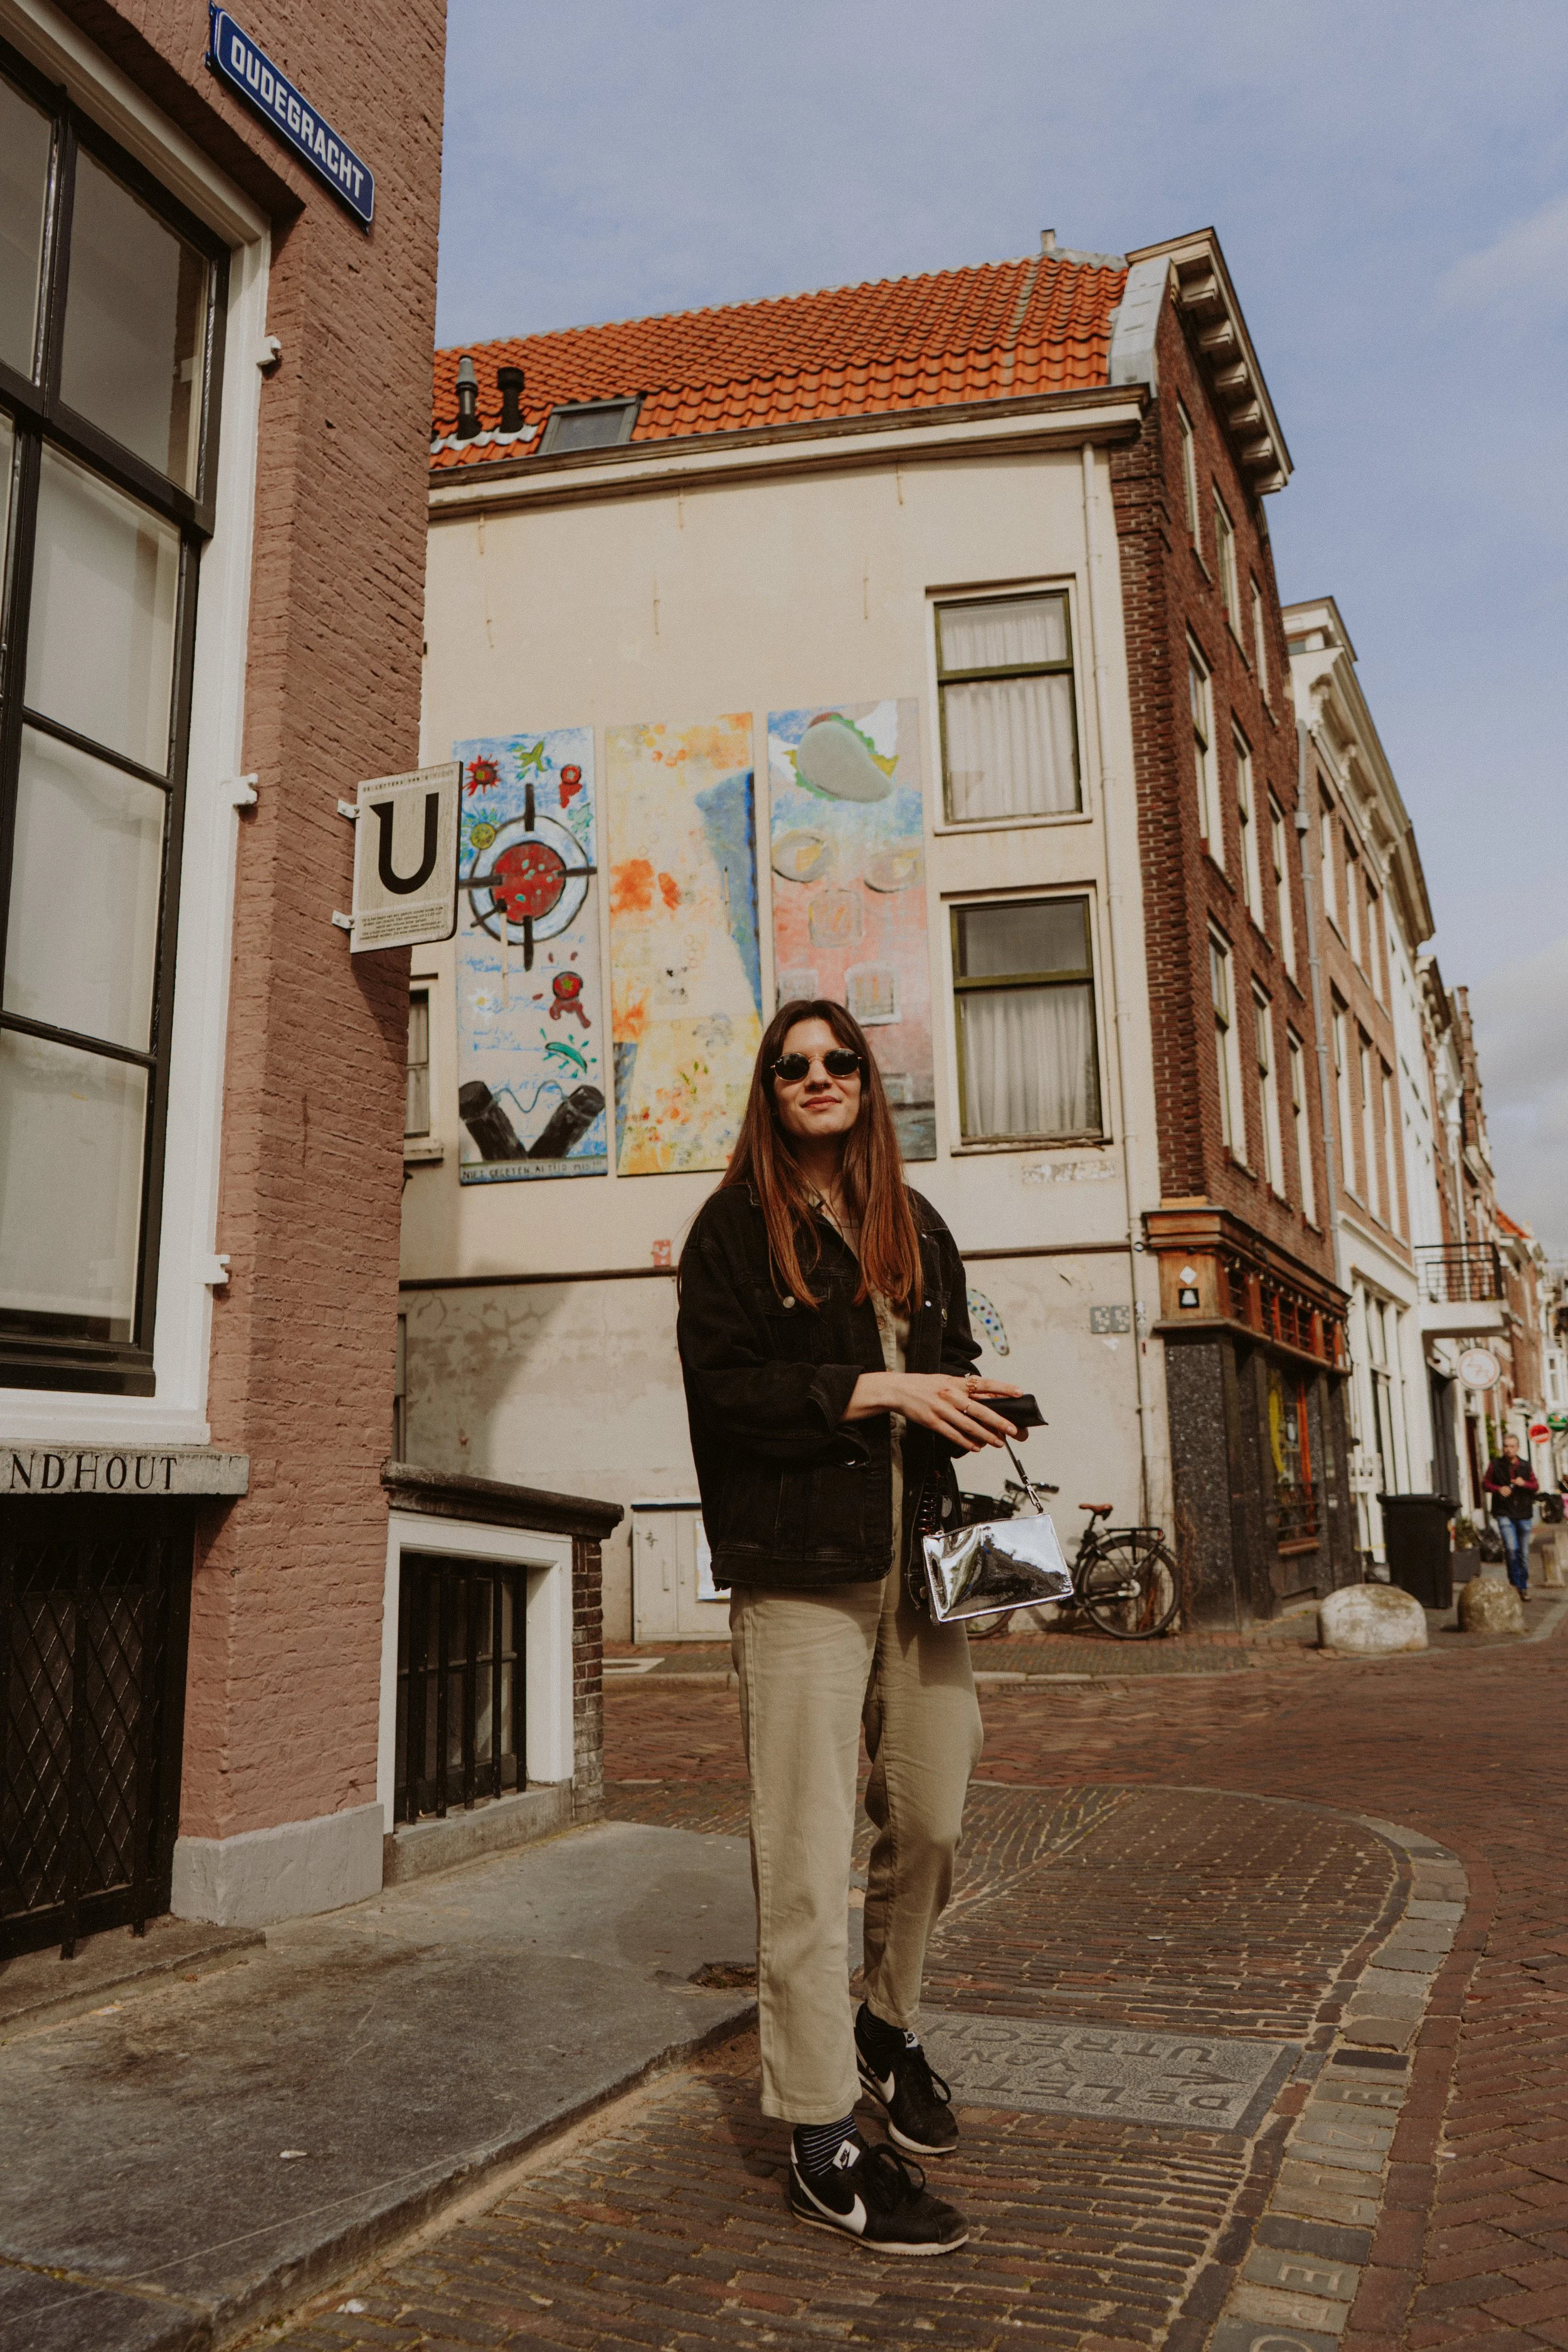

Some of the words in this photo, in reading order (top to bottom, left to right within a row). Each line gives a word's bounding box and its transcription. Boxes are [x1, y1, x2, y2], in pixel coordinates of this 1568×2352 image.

[230, 34, 364, 199] OUDEGRACHT
[369, 792, 439, 895] U
[9, 1454, 177, 1490] NDHOUT
